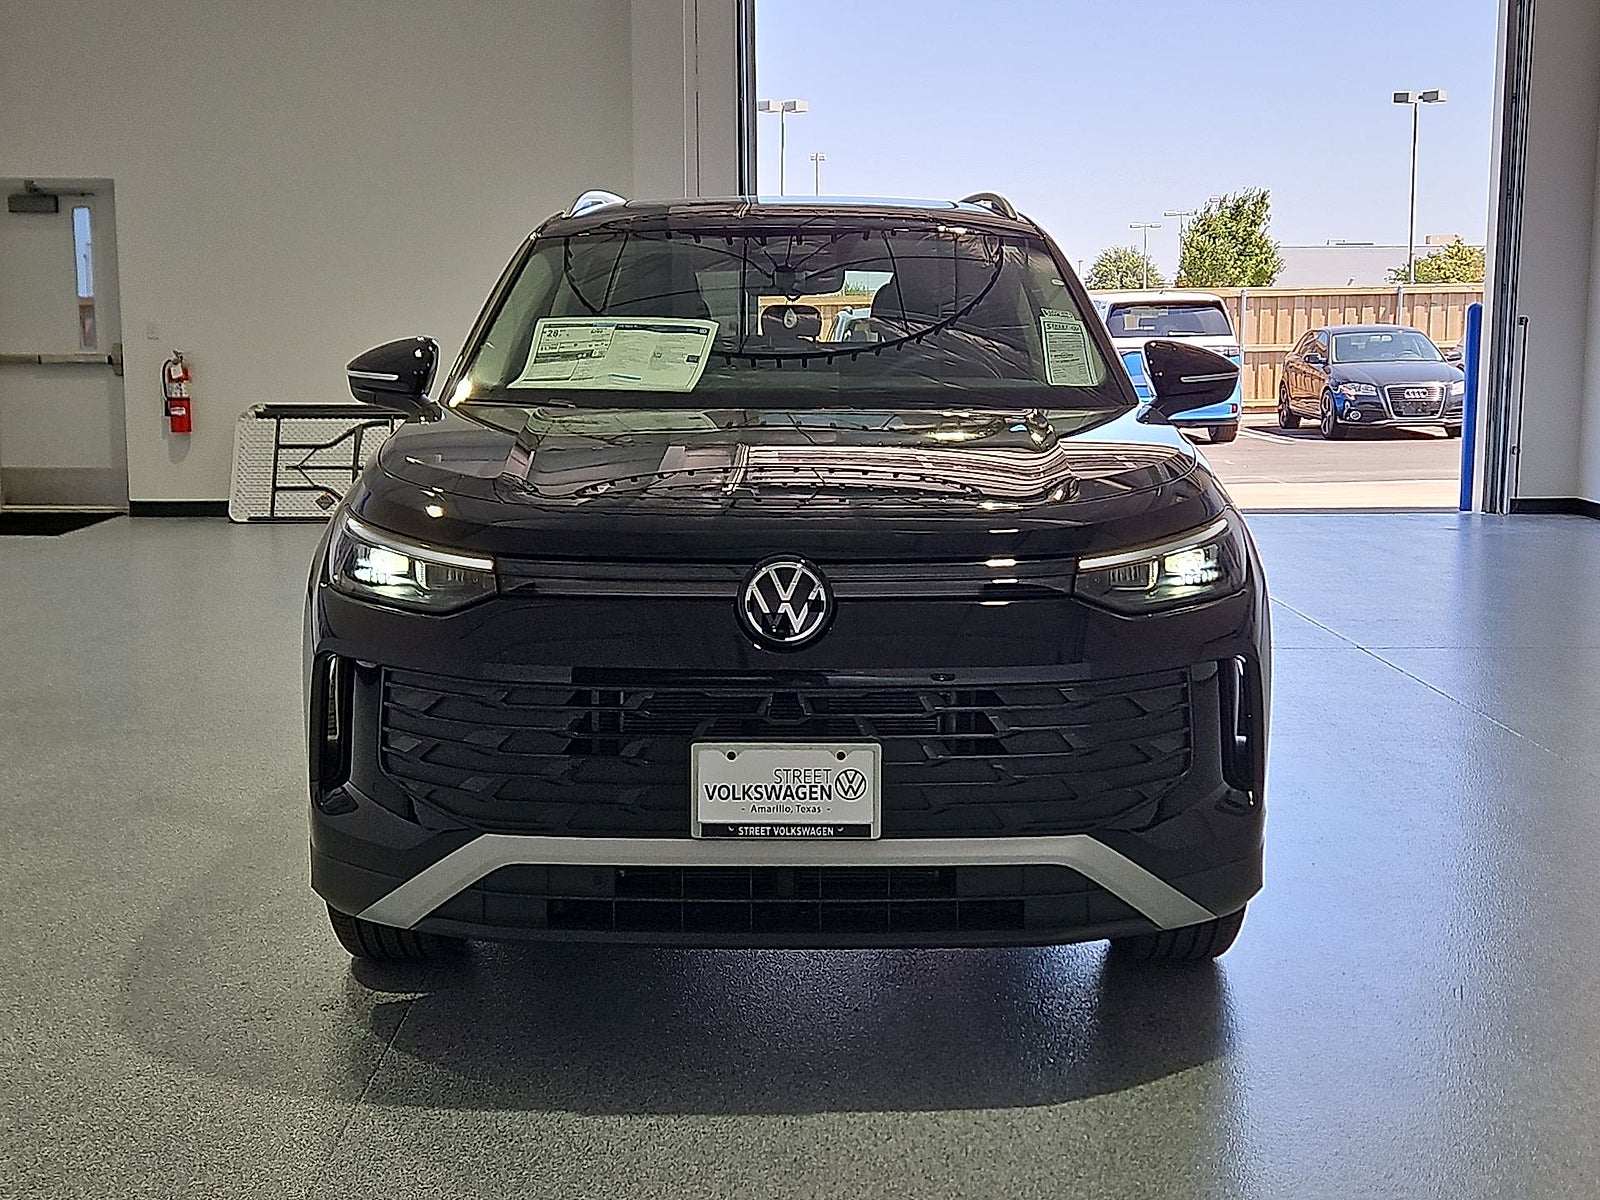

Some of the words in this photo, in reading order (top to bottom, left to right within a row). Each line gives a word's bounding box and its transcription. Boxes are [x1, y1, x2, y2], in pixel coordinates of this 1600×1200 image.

[773, 768, 832, 784] STREET
[704, 784, 833, 801] VOLKSWAGEN
[750, 804, 794, 814] Amarillo,
[795, 804, 822, 814] Texas
[738, 826, 771, 836] STREET
[773, 826, 834, 836] VOLKSWAGEN
